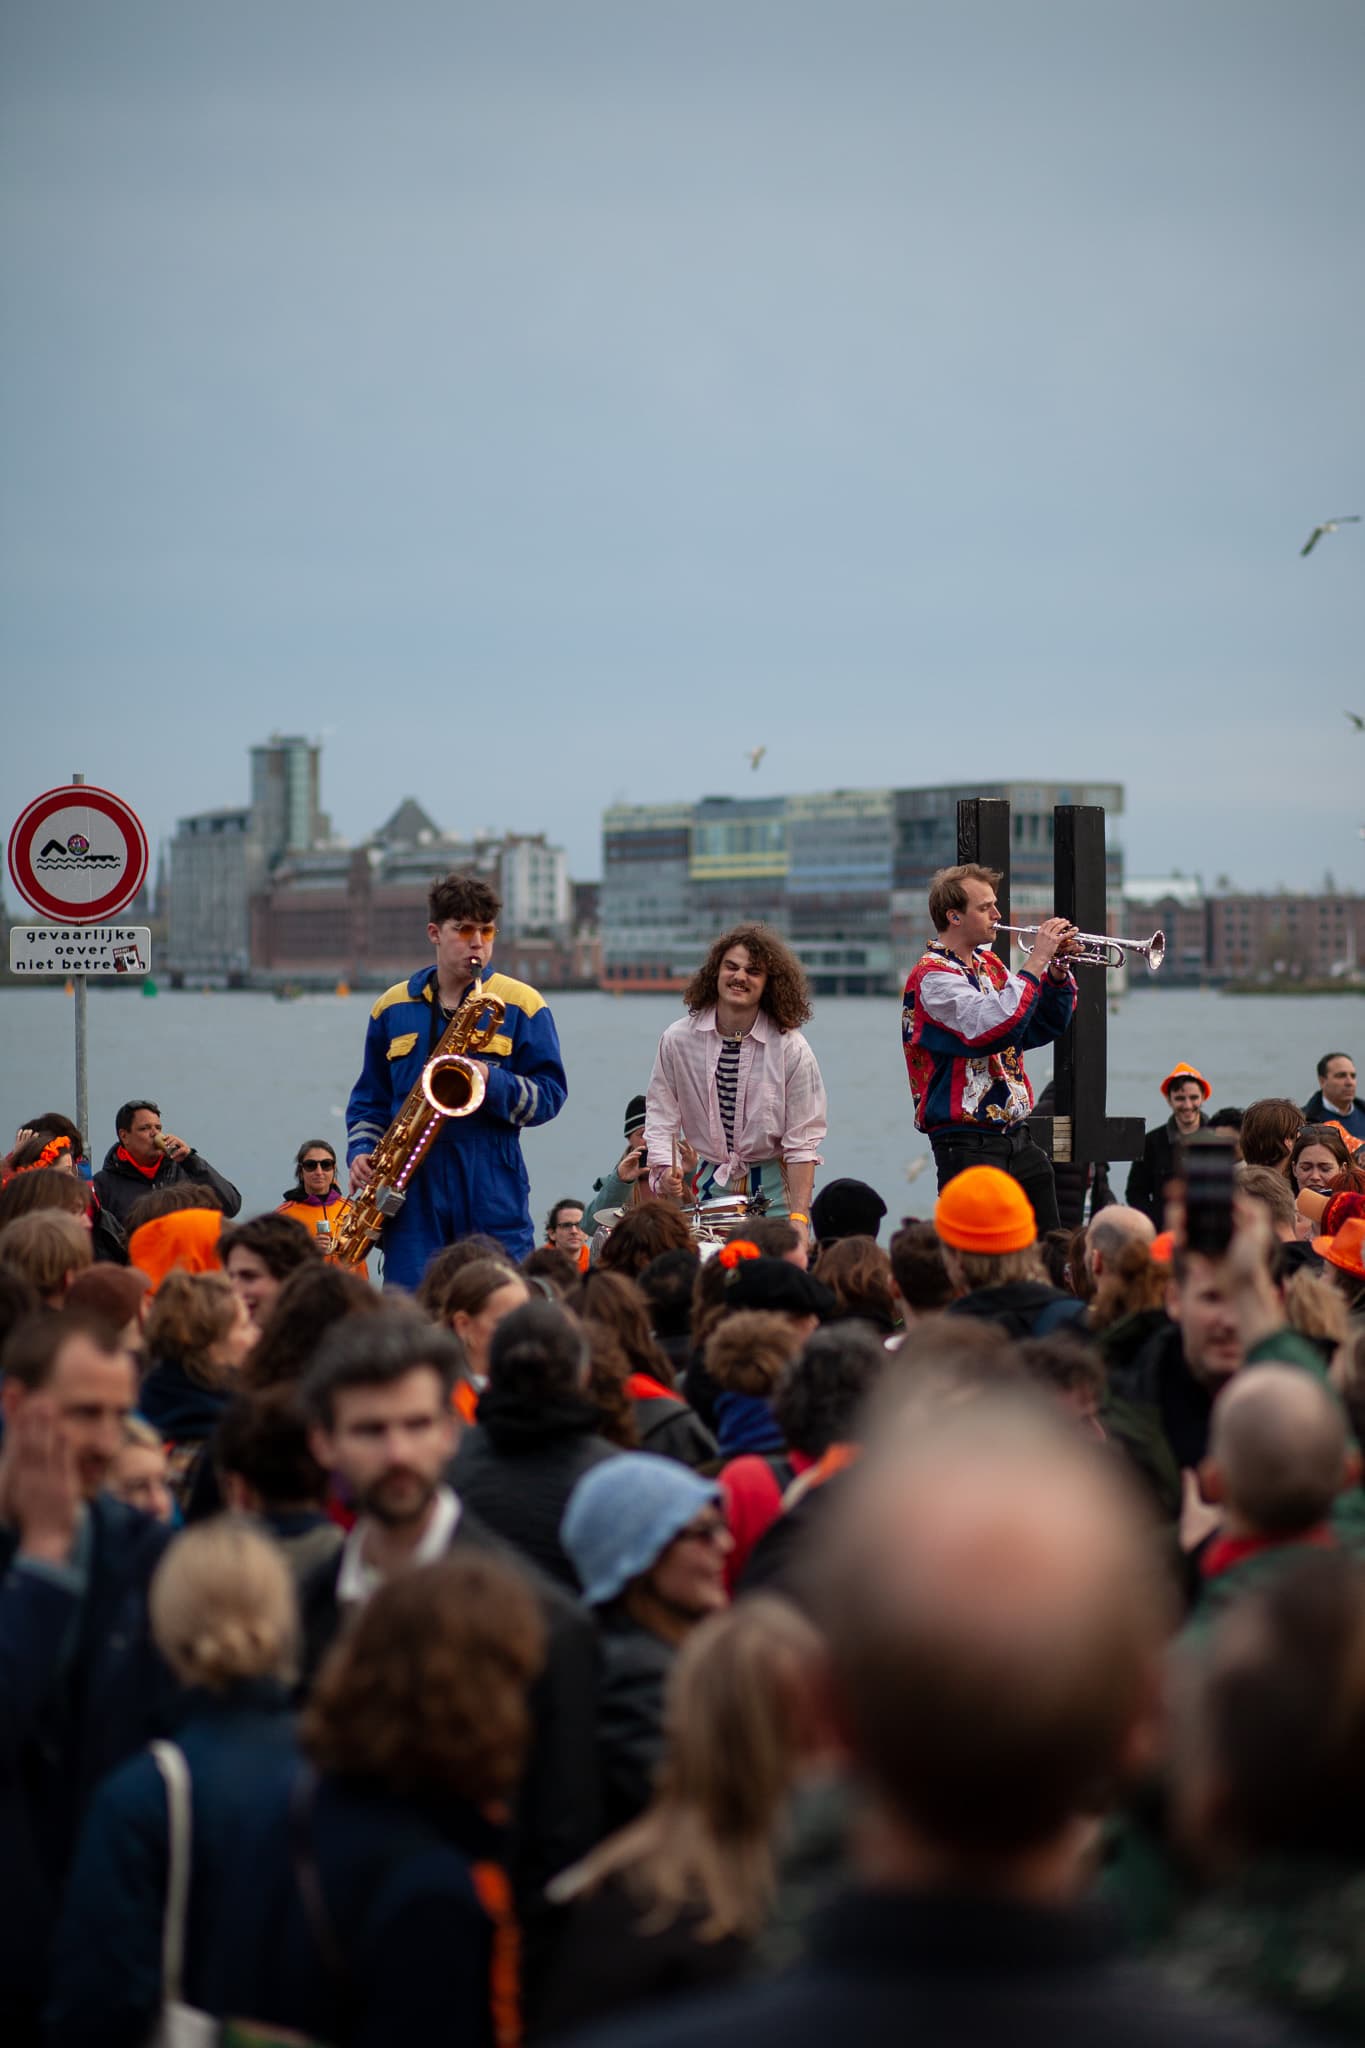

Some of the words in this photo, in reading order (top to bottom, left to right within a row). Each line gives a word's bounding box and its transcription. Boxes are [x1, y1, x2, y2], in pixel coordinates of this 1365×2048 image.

[27, 929, 136, 943] gevaarlijke
[55, 946, 107, 955] oever
[16, 959, 54, 970] niet
[62, 959, 146, 970] betren
